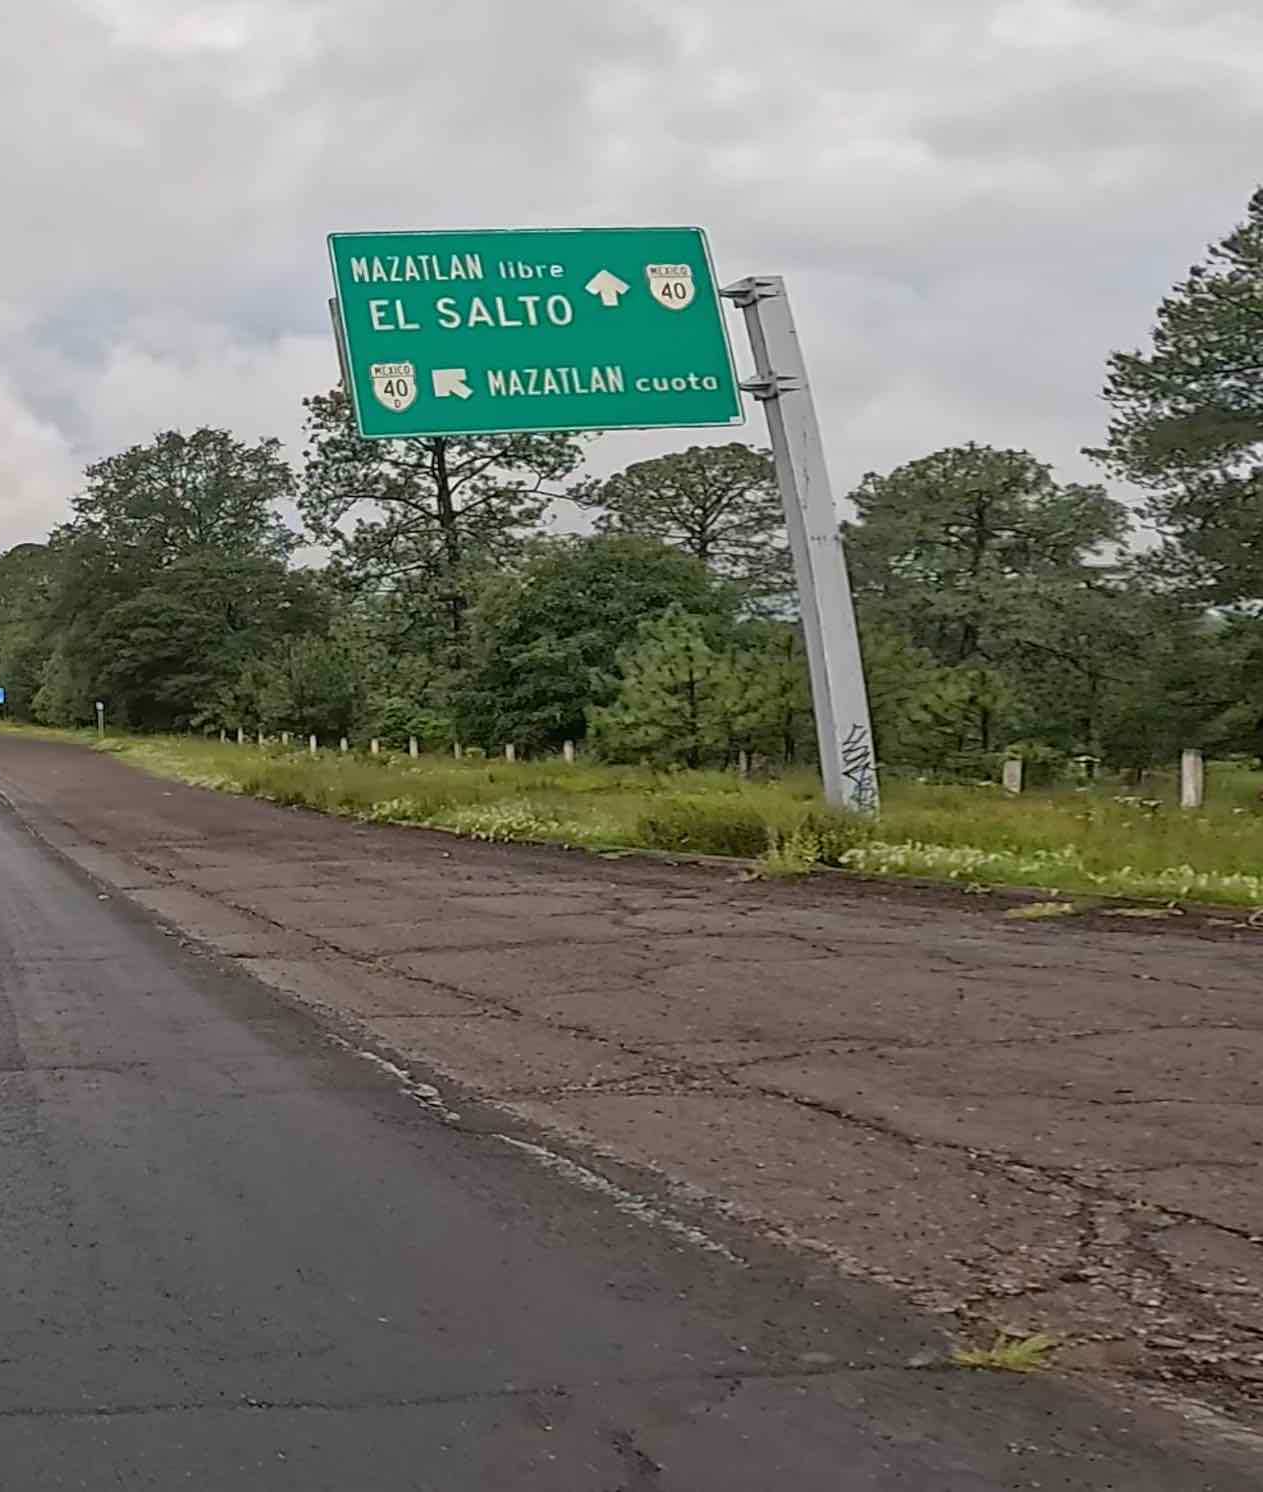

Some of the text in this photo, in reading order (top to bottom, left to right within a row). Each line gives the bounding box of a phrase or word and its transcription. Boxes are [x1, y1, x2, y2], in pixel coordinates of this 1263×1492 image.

[350, 254, 565, 283] MAZATLAN libre
[661, 282, 687, 299] 40
[368, 294, 574, 331] EL SALTO
[383, 379, 408, 397] 40
[487, 366, 718, 397] MAZATLAN cuota
